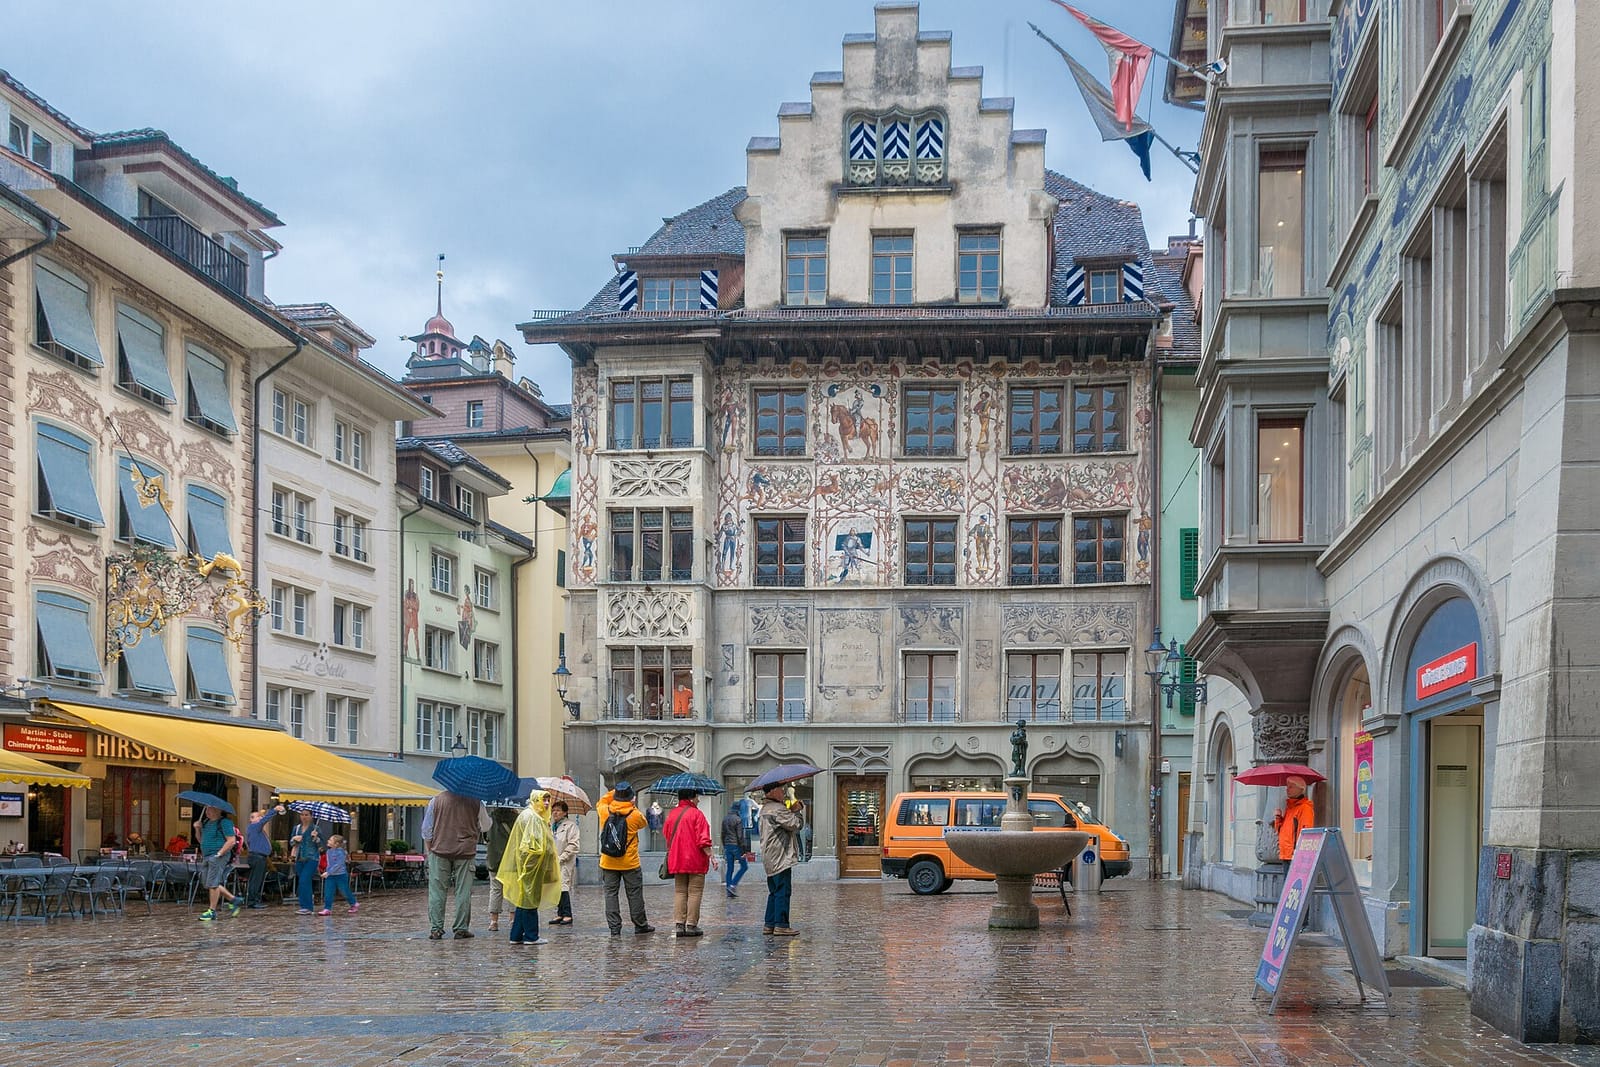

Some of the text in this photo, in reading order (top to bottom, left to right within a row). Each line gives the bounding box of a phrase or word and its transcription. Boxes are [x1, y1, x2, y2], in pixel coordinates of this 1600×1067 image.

[290, 654, 312, 672] Le
[20, 727, 47, 737] Martini
[52, 730, 73, 739] Stube
[7, 740, 80, 753] Chimney's Steakhouse
[97, 734, 188, 762] HIRSC
[854, 826, 873, 834] SALE
